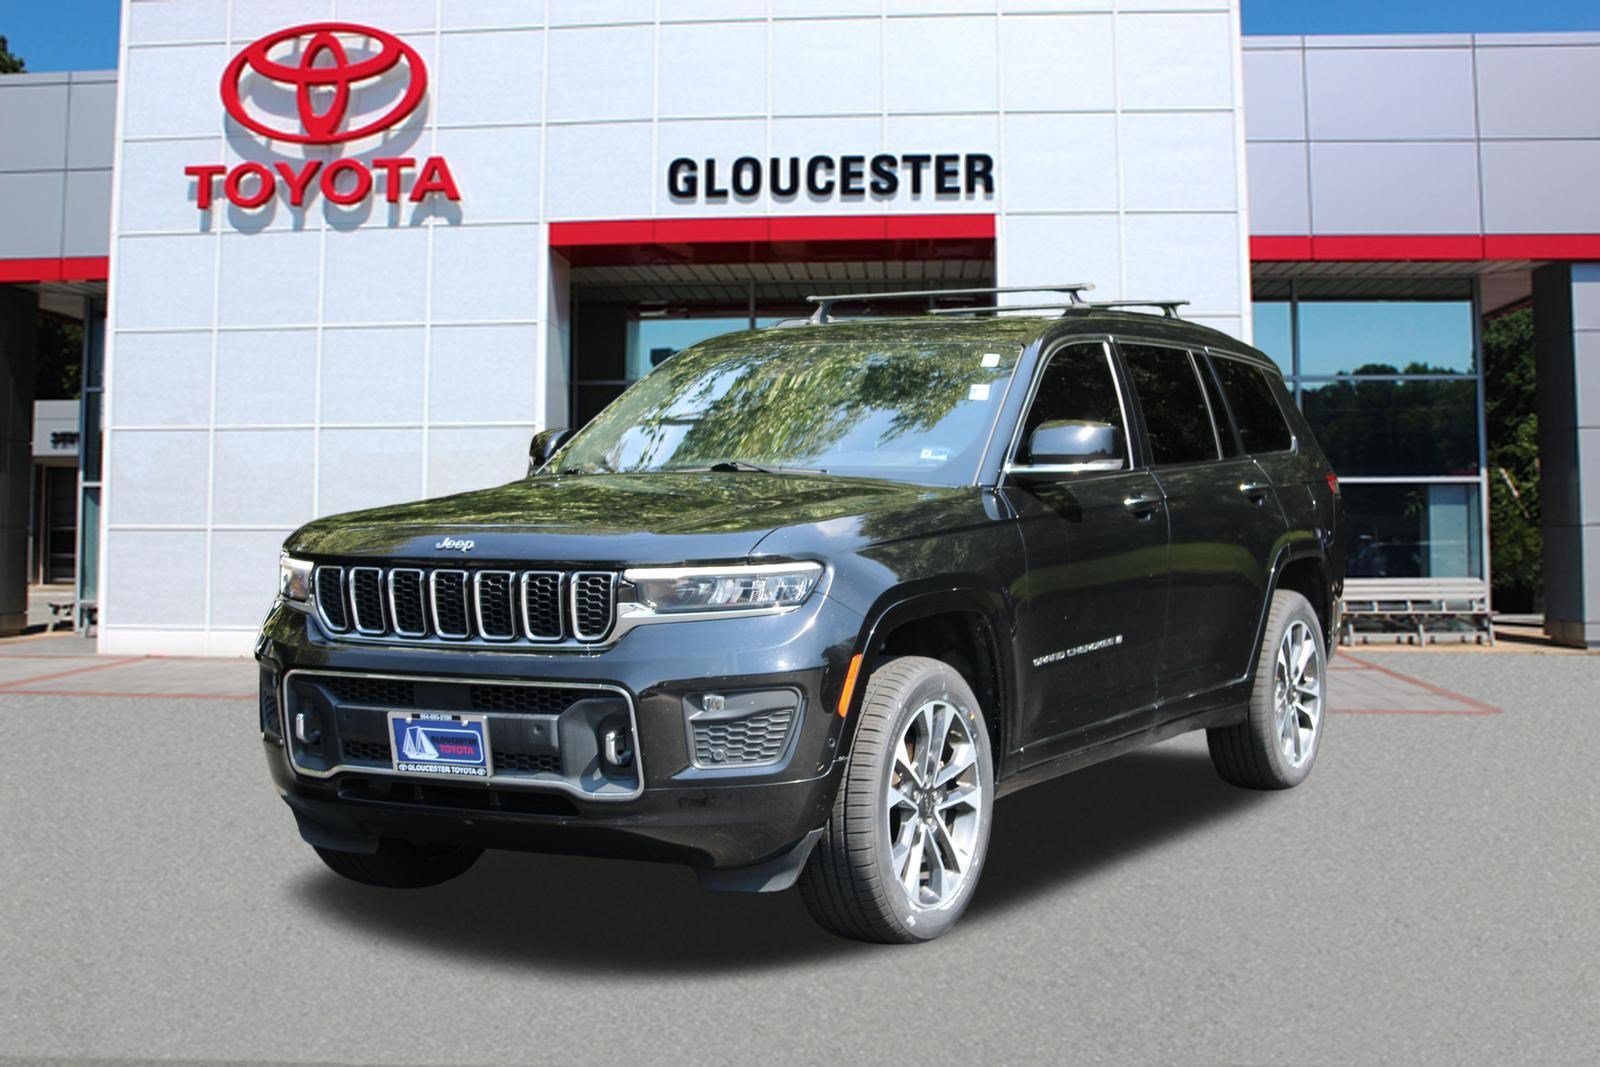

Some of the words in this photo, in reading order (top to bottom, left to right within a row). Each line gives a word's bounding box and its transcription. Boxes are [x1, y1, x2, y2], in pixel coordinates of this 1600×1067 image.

[185, 156, 461, 210] TOYOTA
[667, 153, 995, 198] GLOUCESTER
[435, 537, 475, 552] Jeep
[440, 744, 474, 754] TOYOTA
[408, 764, 450, 772] GLOUCESTER
[452, 767, 477, 775] TOYOTA
